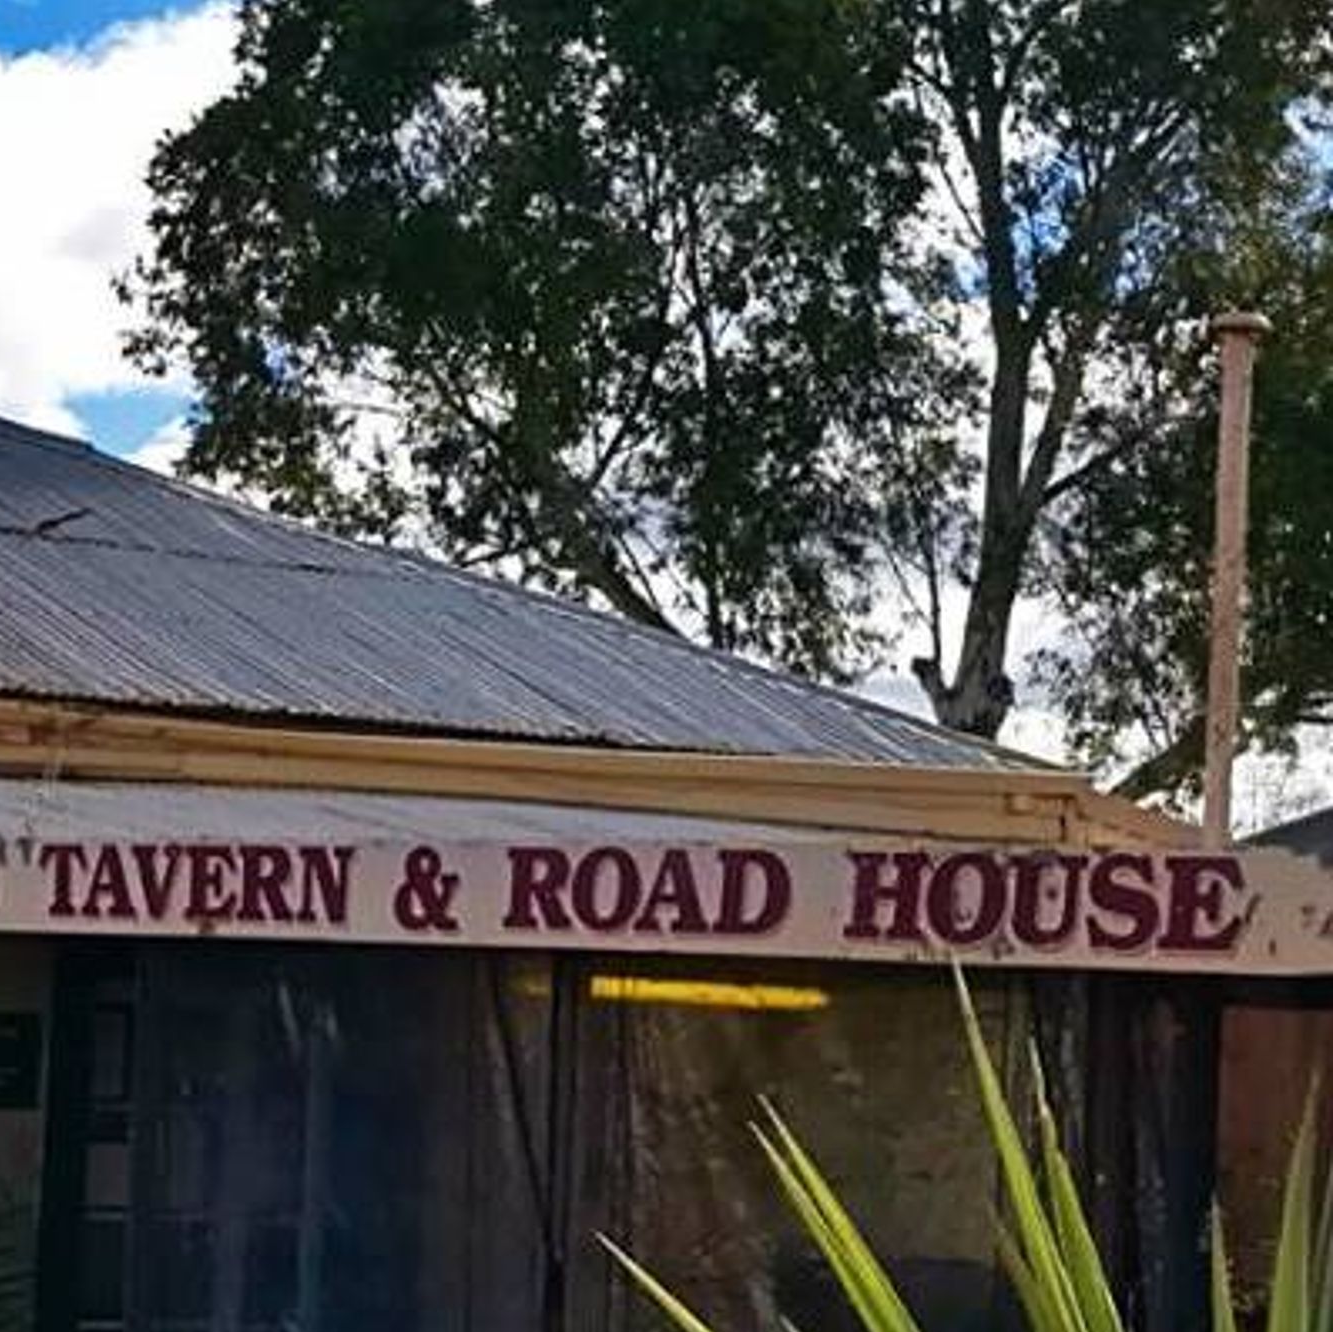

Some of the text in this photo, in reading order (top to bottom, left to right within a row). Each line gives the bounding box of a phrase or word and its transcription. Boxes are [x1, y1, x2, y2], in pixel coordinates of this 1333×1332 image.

[38, 842, 356, 926] TAVERN
[393, 844, 461, 932] &
[501, 845, 794, 935] ROAD
[843, 850, 1247, 951] HOUSE
